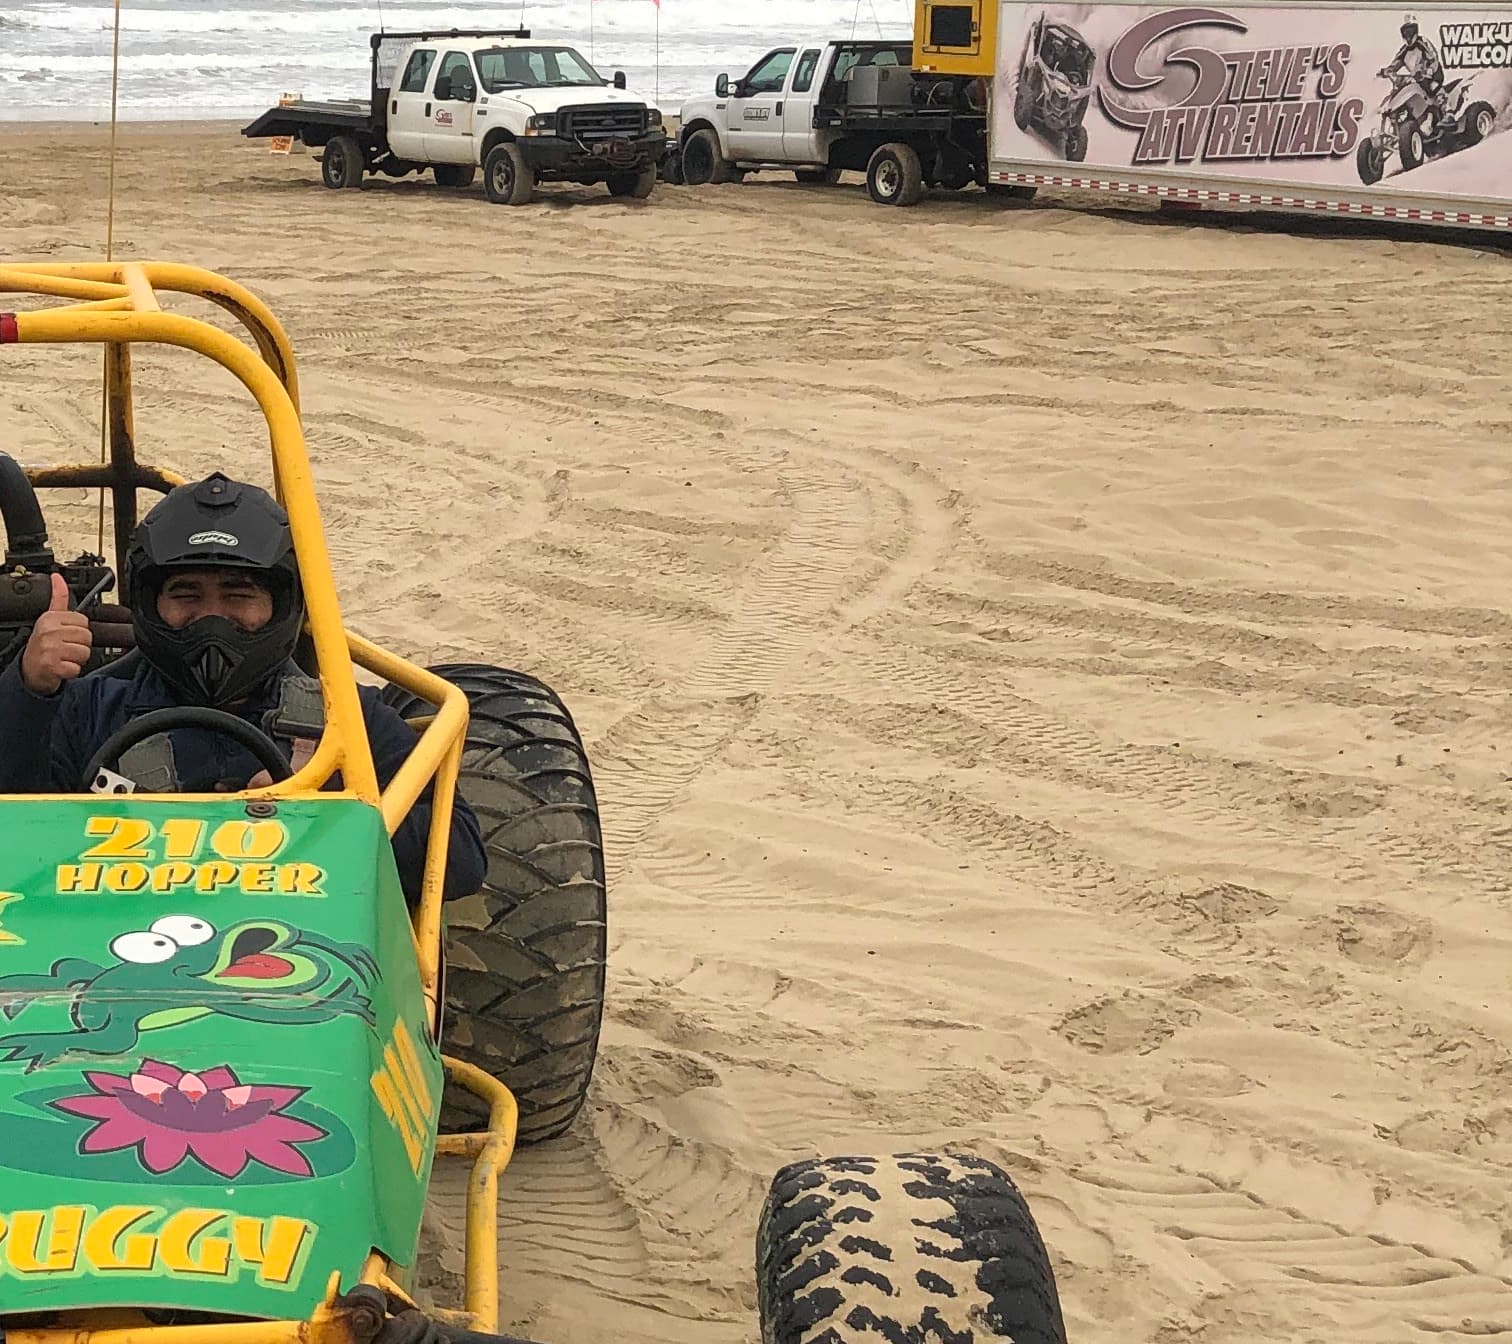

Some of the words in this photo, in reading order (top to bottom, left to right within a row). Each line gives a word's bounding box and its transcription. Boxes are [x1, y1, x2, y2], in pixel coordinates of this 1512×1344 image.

[1098, 7, 1352, 128] STEVE'S
[1134, 105, 1211, 162] ATV
[1203, 98, 1365, 159] RENTALS
[80, 817, 286, 860] 210
[57, 861, 324, 895] HOPPER
